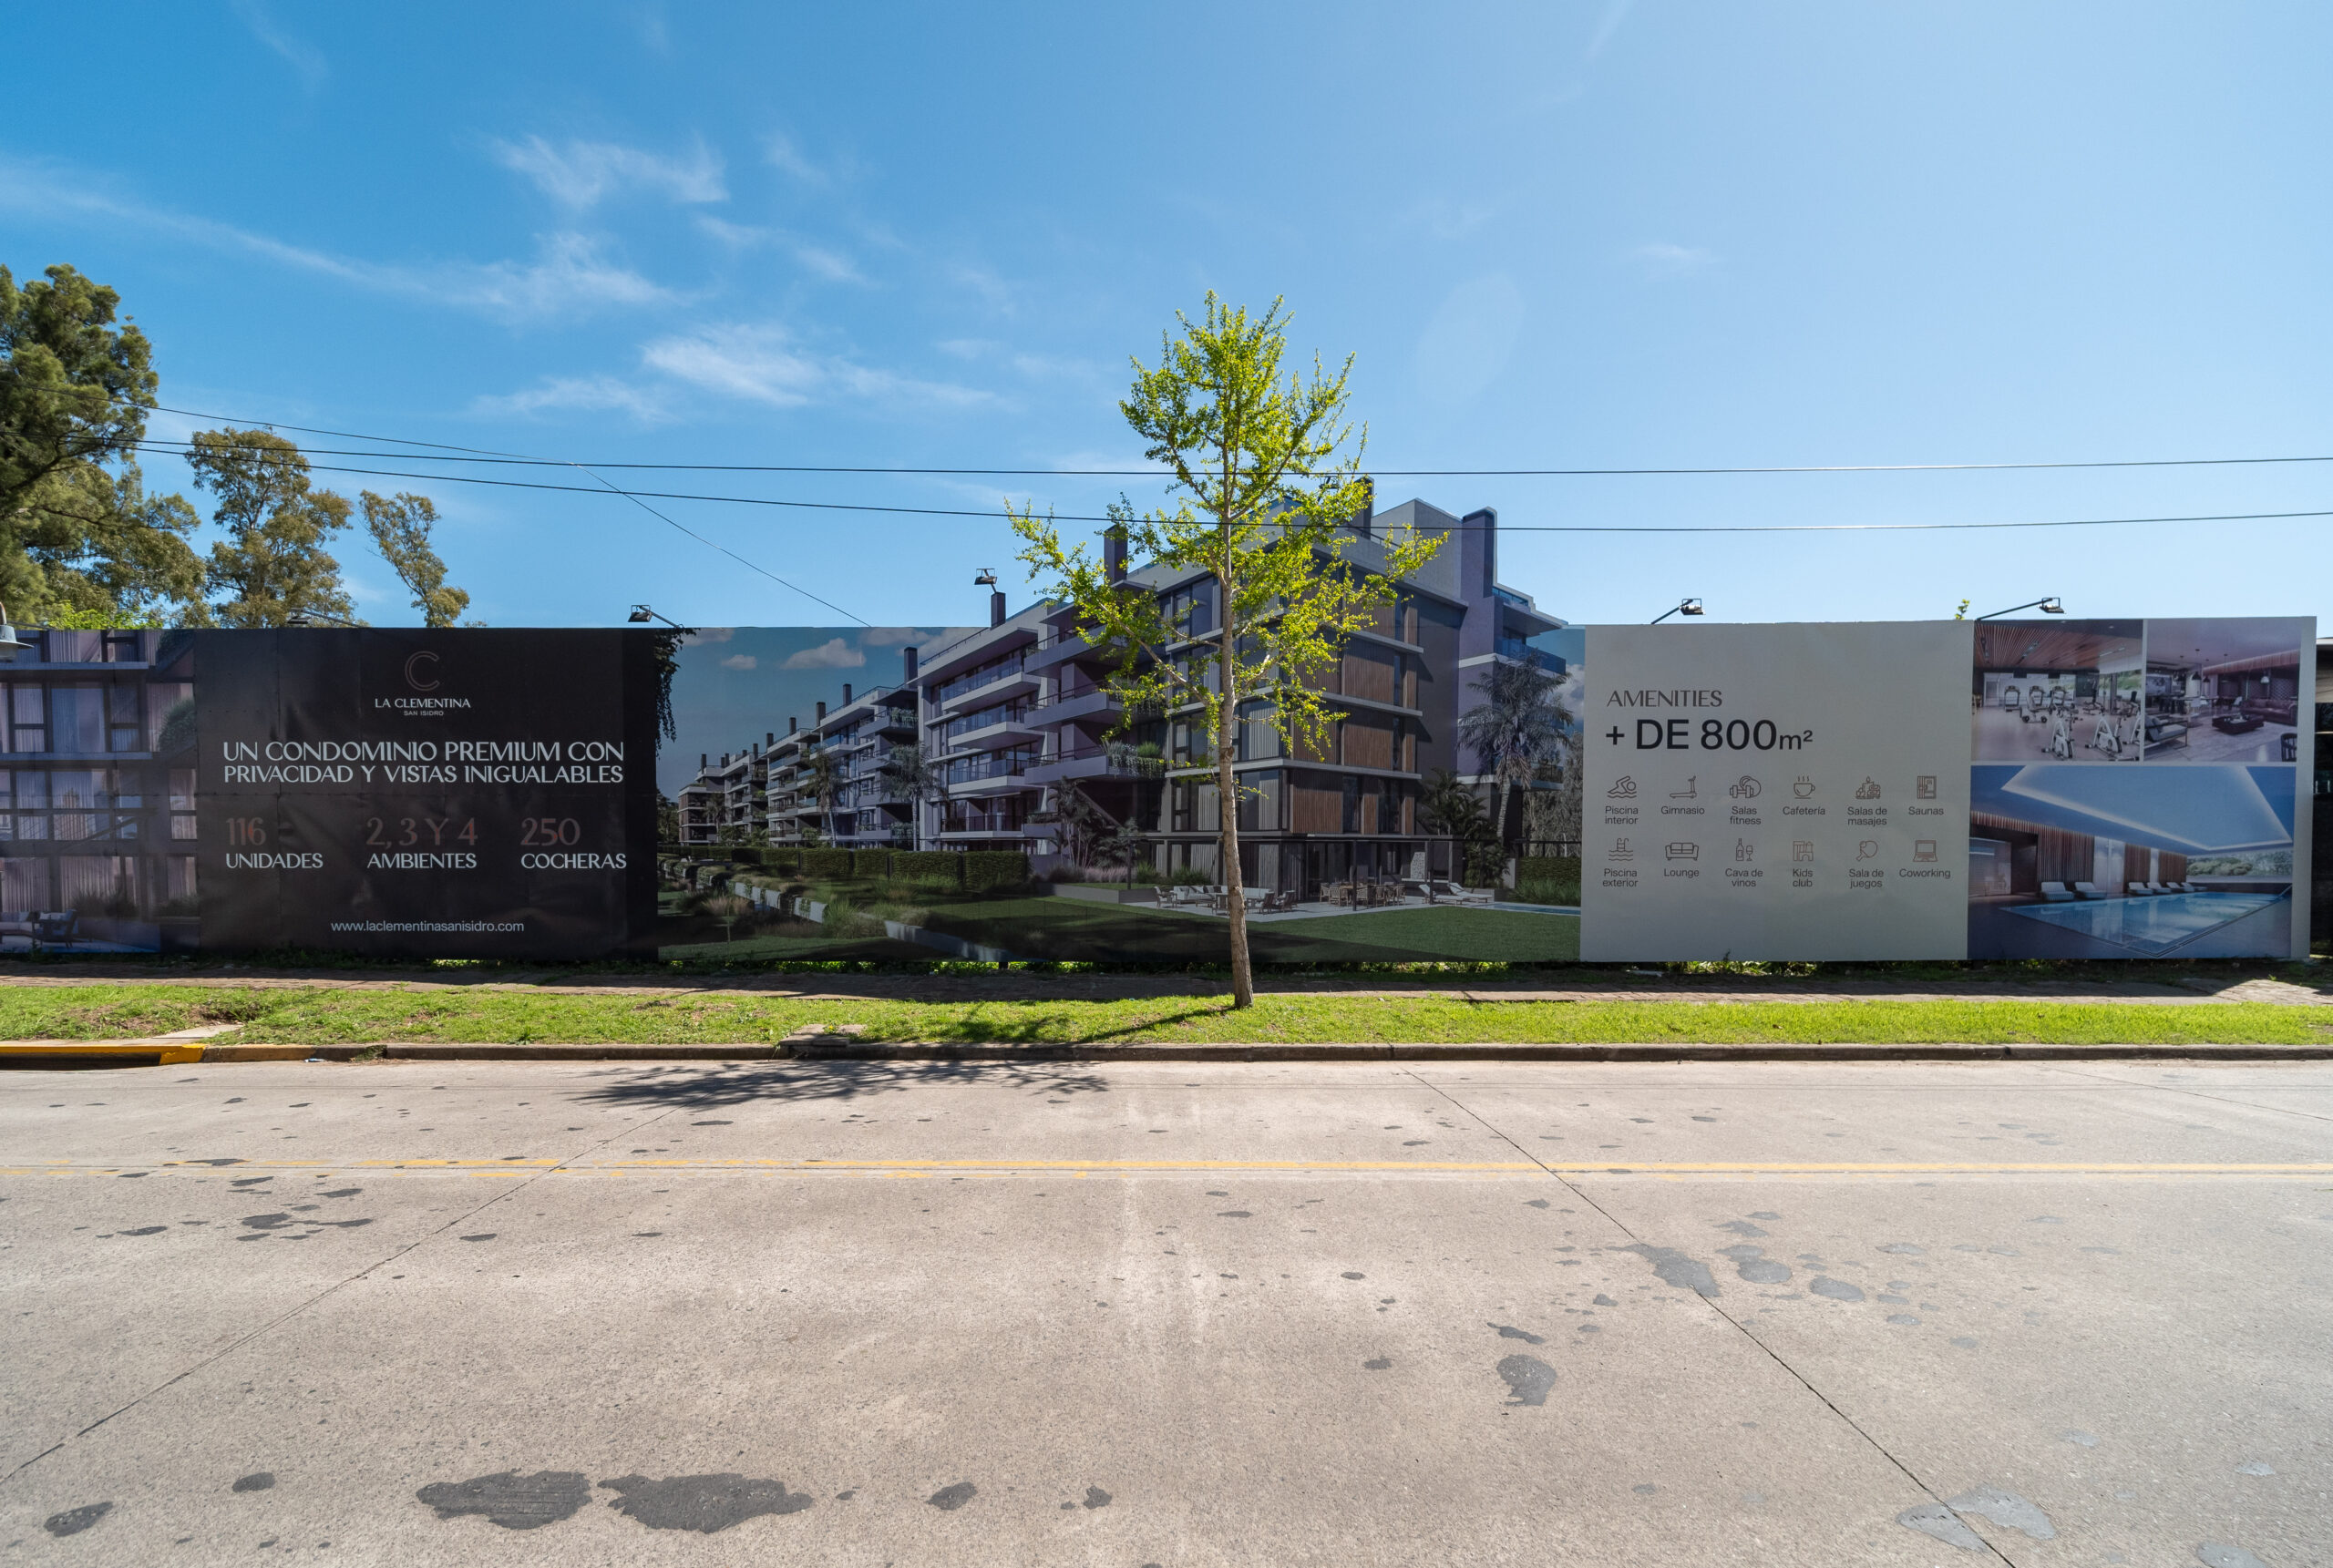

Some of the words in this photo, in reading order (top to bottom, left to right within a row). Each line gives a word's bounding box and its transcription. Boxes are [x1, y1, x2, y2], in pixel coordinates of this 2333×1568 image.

[374, 697, 392, 709] LA
[394, 697, 471, 709] CLEMENTINA
[1606, 689, 1723, 708] AMENITIES
[1635, 718, 1690, 751] DE
[222, 741, 259, 762] UN
[265, 741, 438, 762] CONDOMINIO
[445, 741, 561, 762] PREMIUM
[568, 741, 625, 762] CON
[223, 764, 354, 784] PRIVACIDAD
[360, 764, 376, 784] Y
[384, 764, 458, 784] VISTAS
[464, 764, 624, 784] INIGUALABLES
[1604, 805, 1639, 815] Piscina
[1660, 805, 1705, 815] Gimnasio
[1732, 805, 1758, 815] Salas
[1782, 805, 1826, 815] Cafetería
[1846, 805, 1873, 815] Salas
[1875, 805, 1888, 815] de
[1907, 805, 1945, 815] Saunas
[1604, 815, 1639, 825] interior
[1729, 815, 1762, 825] fitness
[1847, 816, 1887, 826] masajes
[225, 817, 267, 846] 116
[365, 817, 393, 851] 2,
[398, 817, 418, 846] 3
[428, 817, 449, 846] Y
[458, 817, 479, 846] 4
[520, 817, 581, 846] 250
[225, 852, 324, 869] UNIDADES
[366, 852, 478, 869] AMBIENTES
[519, 852, 628, 869] COCHERAS
[1603, 867, 1638, 877] Piscina
[1663, 867, 1700, 878] Lounge
[1724, 867, 1748, 877] Cava
[1750, 867, 1763, 877] de
[1792, 867, 1814, 877] Kids
[1848, 868, 1870, 877] Sala
[1871, 868, 1885, 877] de
[1898, 868, 1951, 879] Coworking
[1602, 878, 1639, 887] exterior
[1731, 878, 1757, 887] vinos
[1792, 878, 1814, 887] club
[1849, 878, 1883, 889] juegos
[330, 919, 525, 932] www.laclementinasanisidro.com
